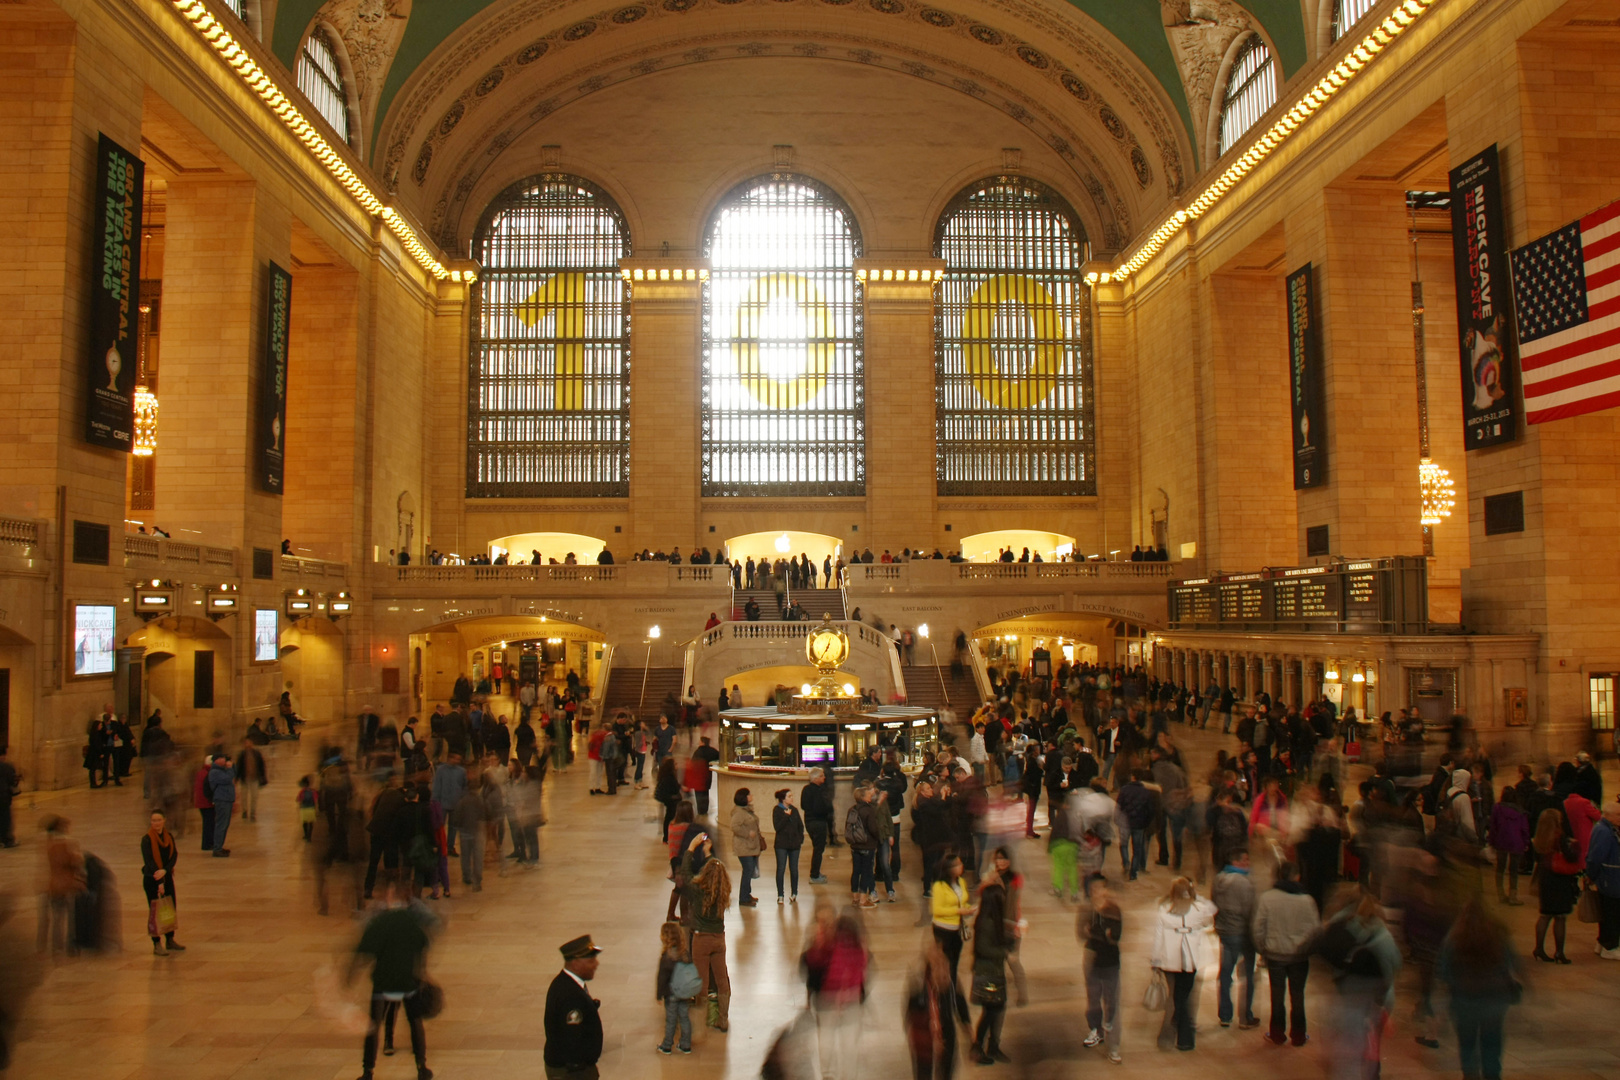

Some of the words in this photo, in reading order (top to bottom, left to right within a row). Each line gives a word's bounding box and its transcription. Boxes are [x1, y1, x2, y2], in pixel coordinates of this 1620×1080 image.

[108, 152, 118, 192] THE
[116, 157, 127, 196] 100
[123, 163, 134, 240] GRAND
[1475, 184, 1488, 250] NICK
[103, 196, 116, 290] MAKING
[113, 201, 125, 272] YEARS
[112, 276, 122, 300] IN
[118, 244, 131, 341] CENTRAL
[1300, 274, 1308, 330] GRAND
[1479, 252, 1493, 319] CAVE
[1294, 336, 1302, 406] CENTRAL
[113, 430, 130, 442] CBRE
[520, 608, 564, 619] LEXINGTON
[997, 606, 1040, 619] LEXINGTON
[1108, 606, 1145, 619] MACHINES
[498, 632, 521, 640] STREET
[975, 628, 997, 637] STREET
[736, 663, 755, 672] TRACKS
